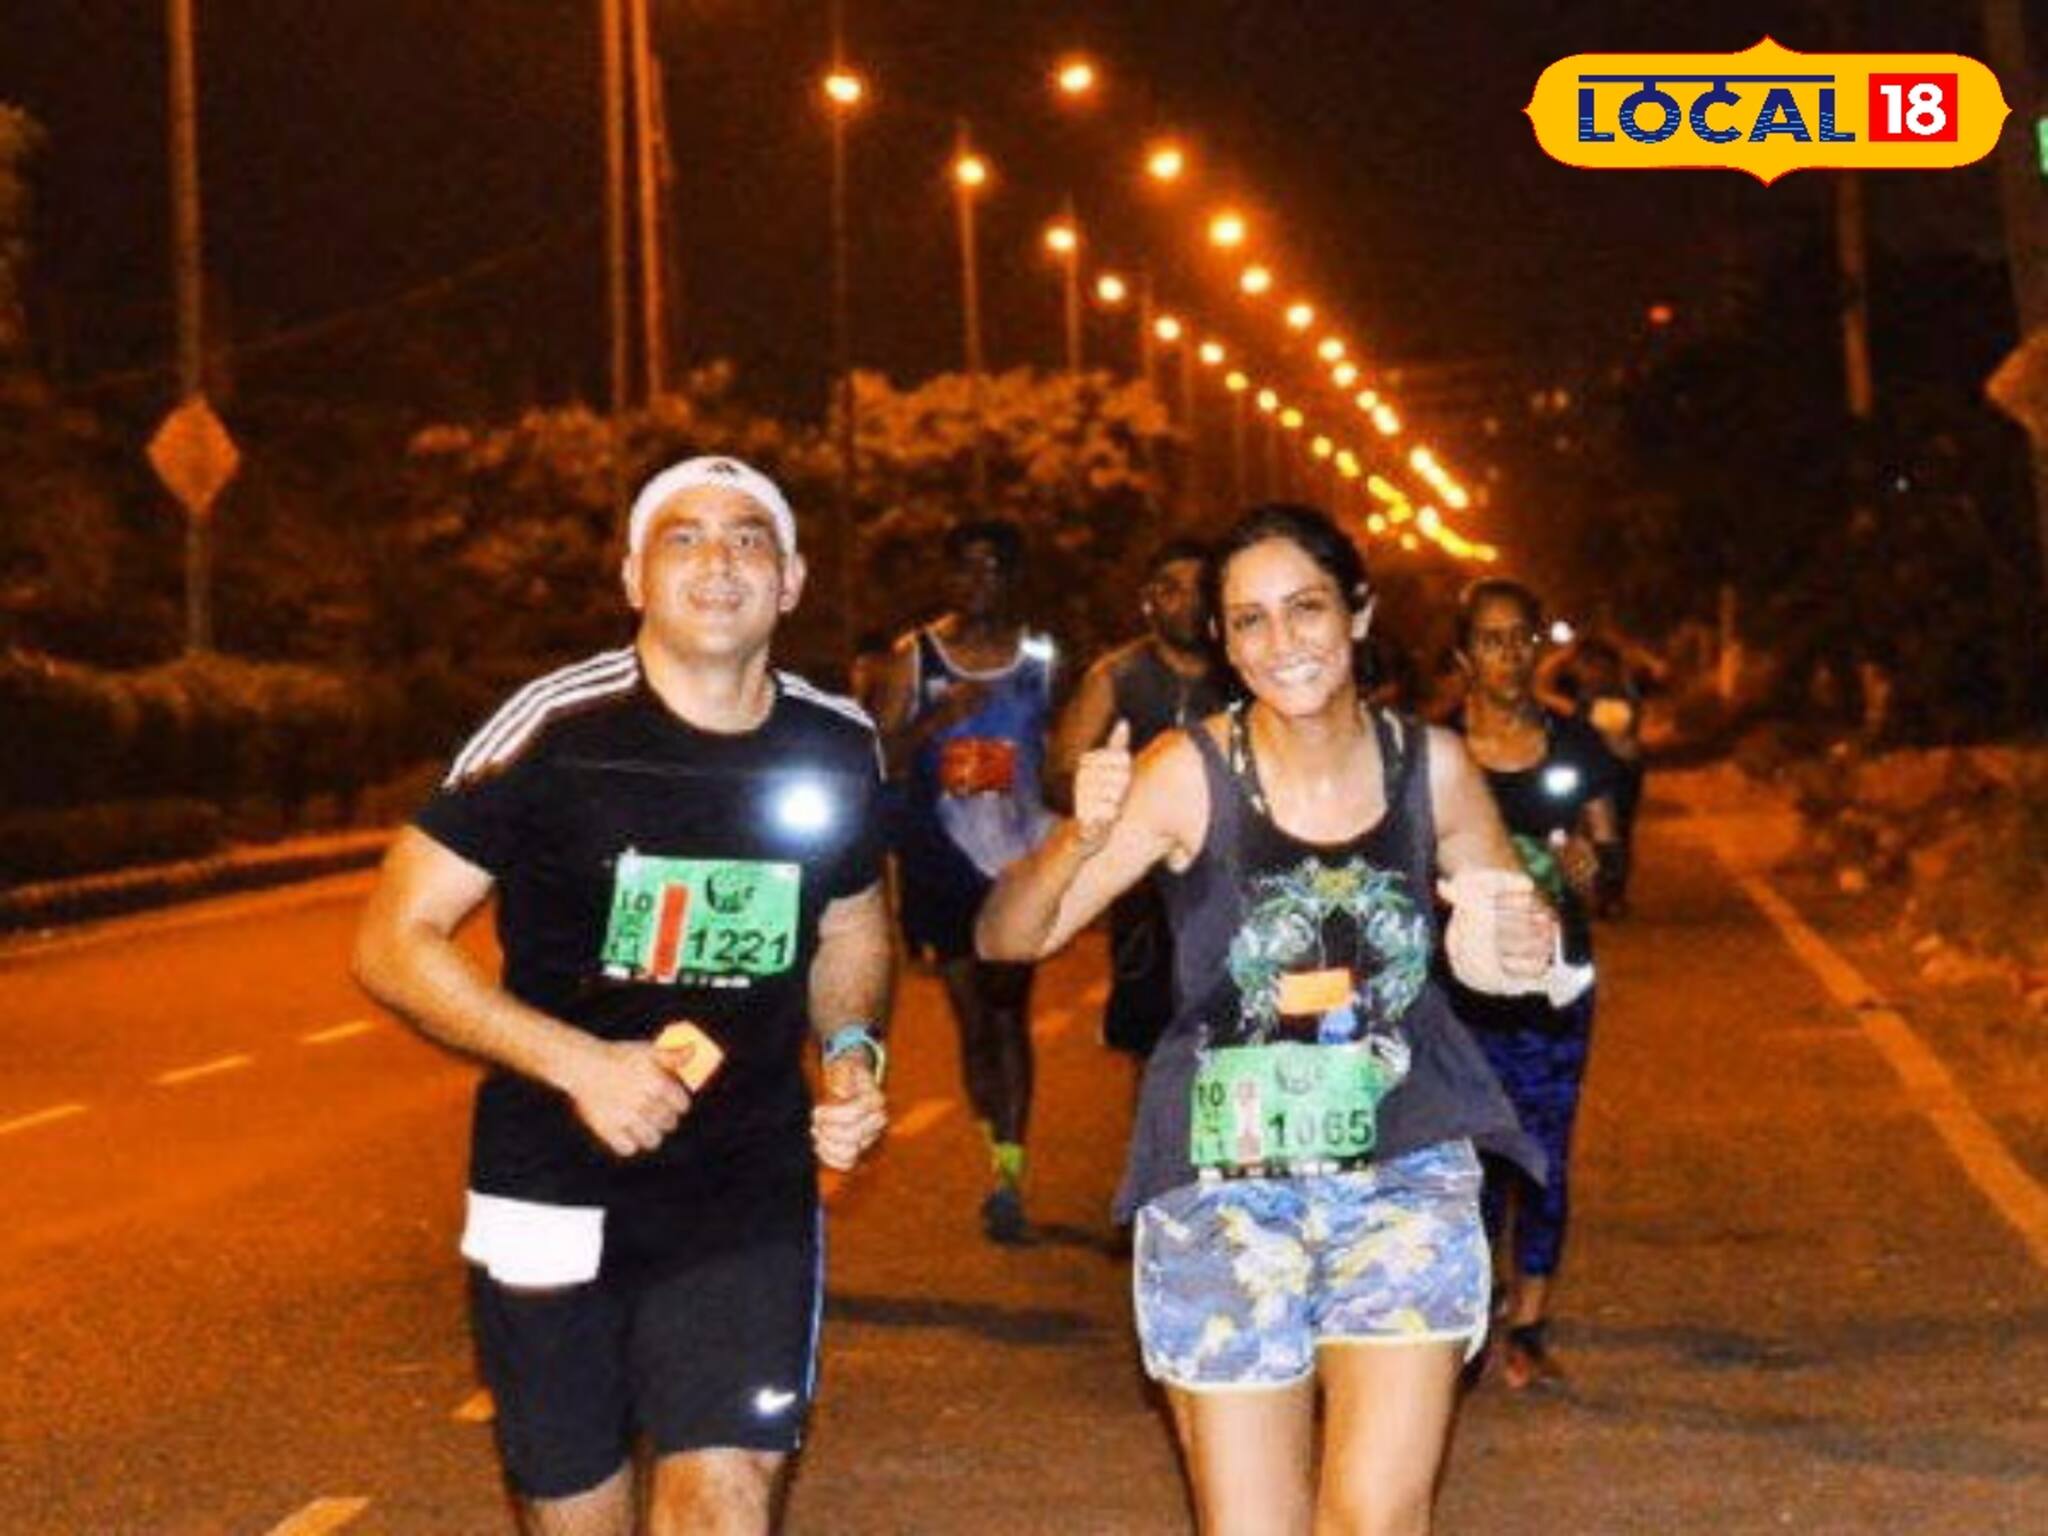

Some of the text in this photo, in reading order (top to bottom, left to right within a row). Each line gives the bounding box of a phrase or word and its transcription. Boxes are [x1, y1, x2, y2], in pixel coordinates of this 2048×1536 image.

[689, 929, 789, 965] 1221
[1198, 1080, 1226, 1107] 10
[1268, 1109, 1371, 1146] 1065
